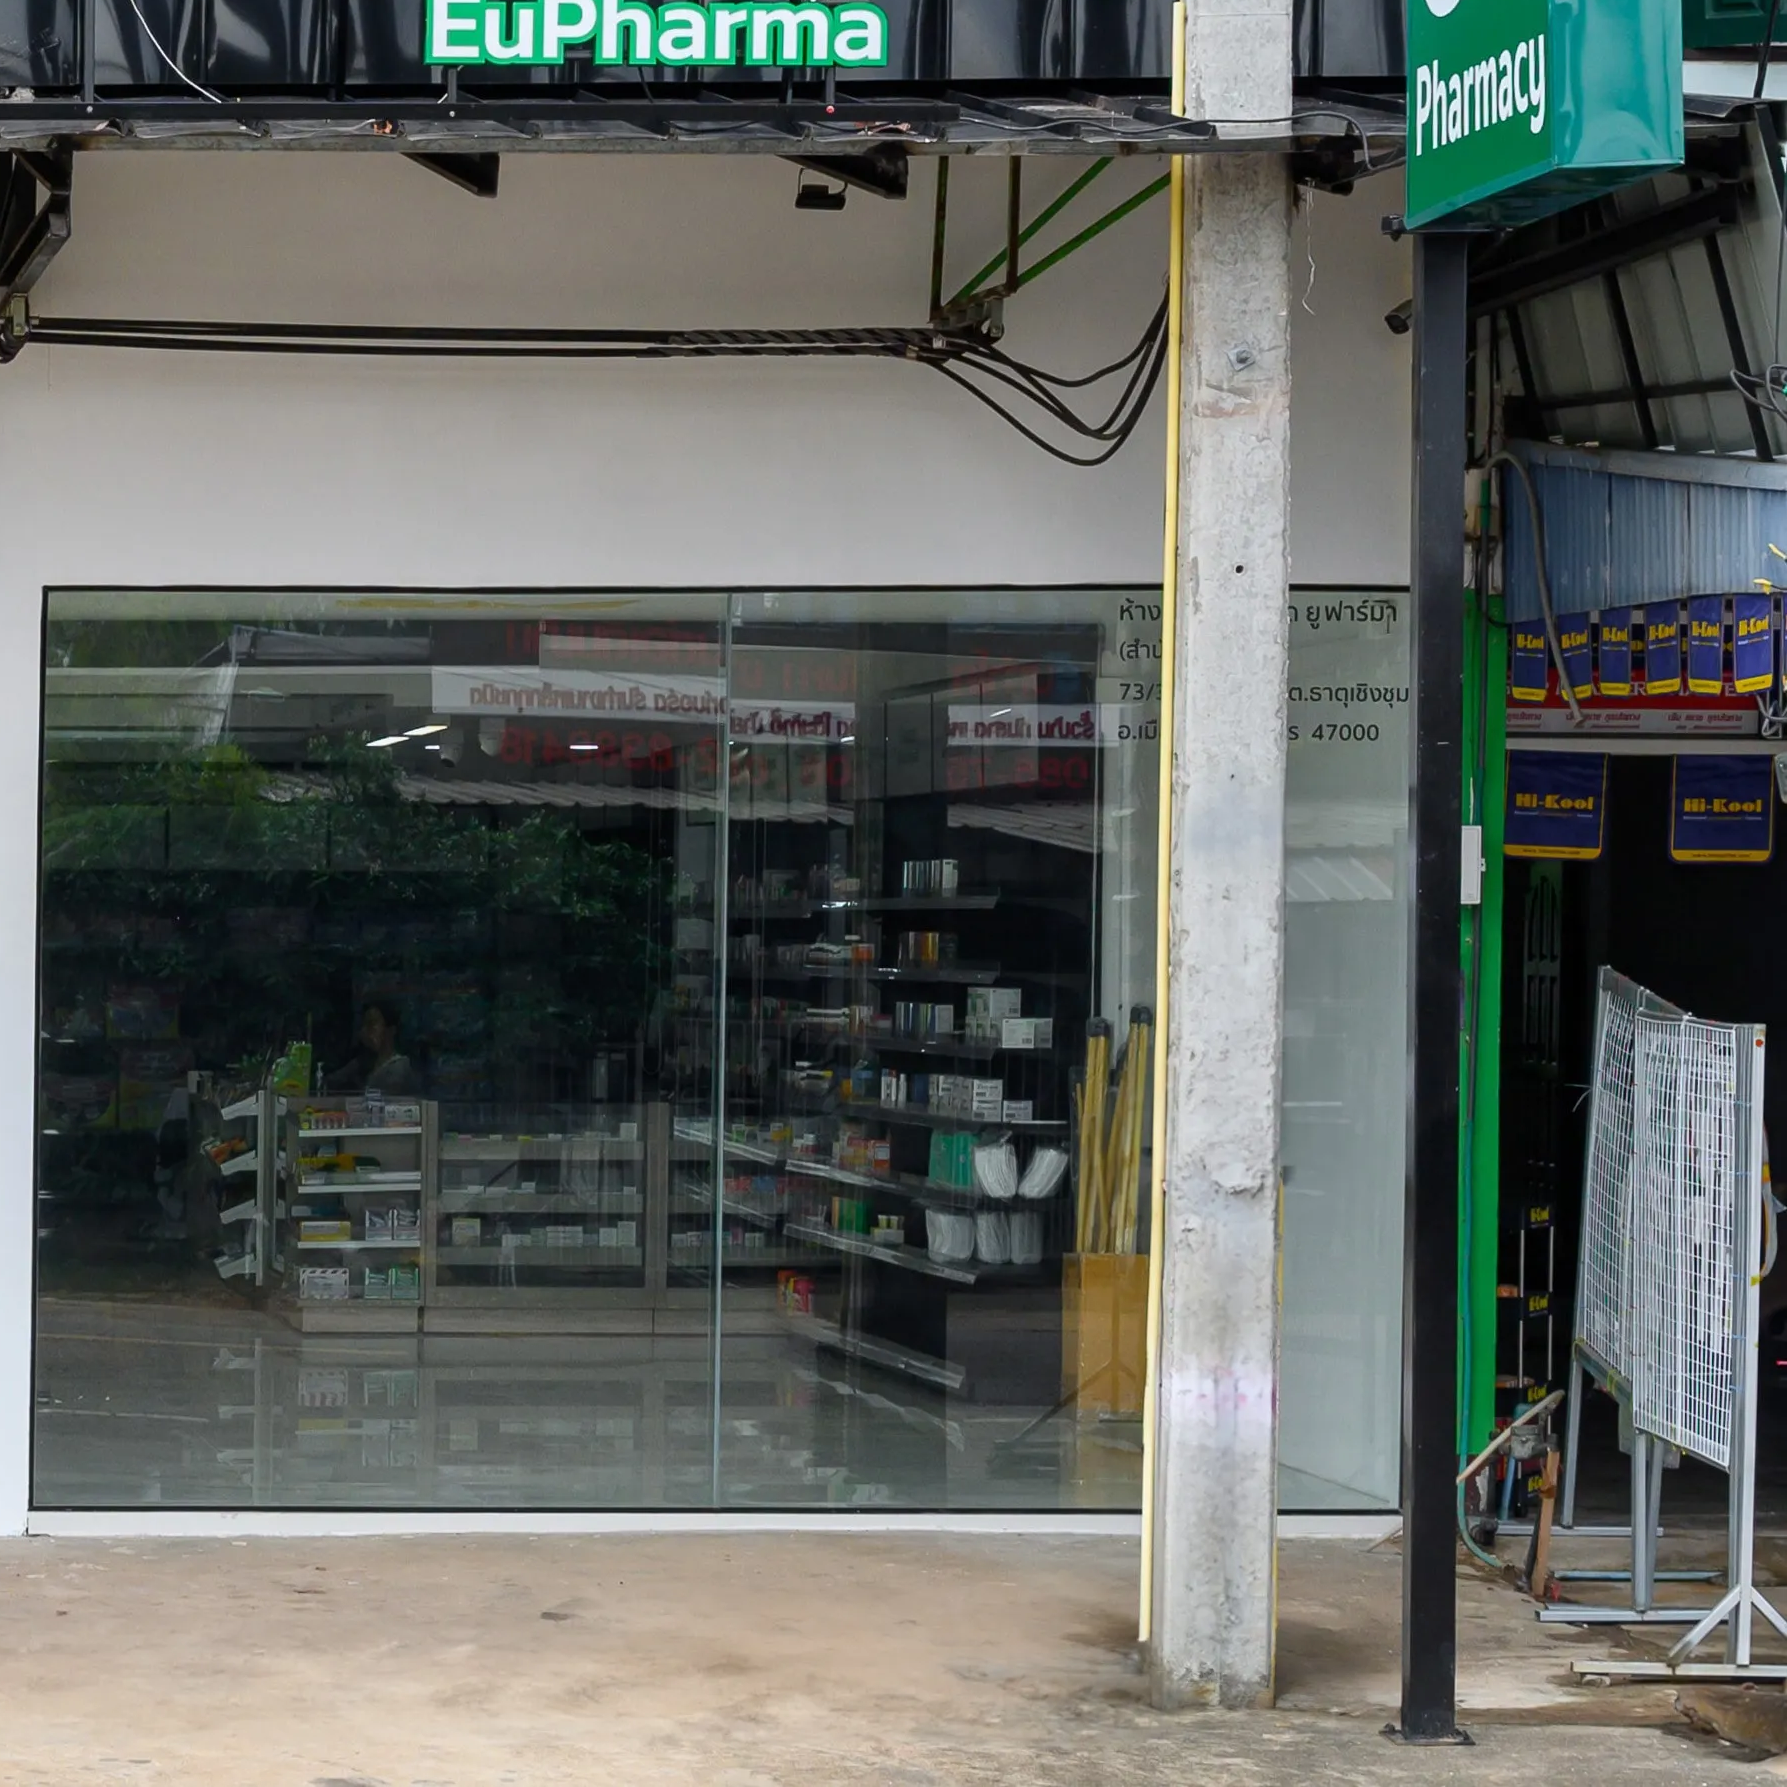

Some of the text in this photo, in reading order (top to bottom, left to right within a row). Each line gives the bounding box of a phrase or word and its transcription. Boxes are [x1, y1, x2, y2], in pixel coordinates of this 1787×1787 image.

[1415, 32, 1546, 156] Pharmacy
[1311, 723, 1380, 742] 47000
[1515, 792, 1594, 811] Hi-Kool
[1682, 797, 1763, 814] Hi-Kool
